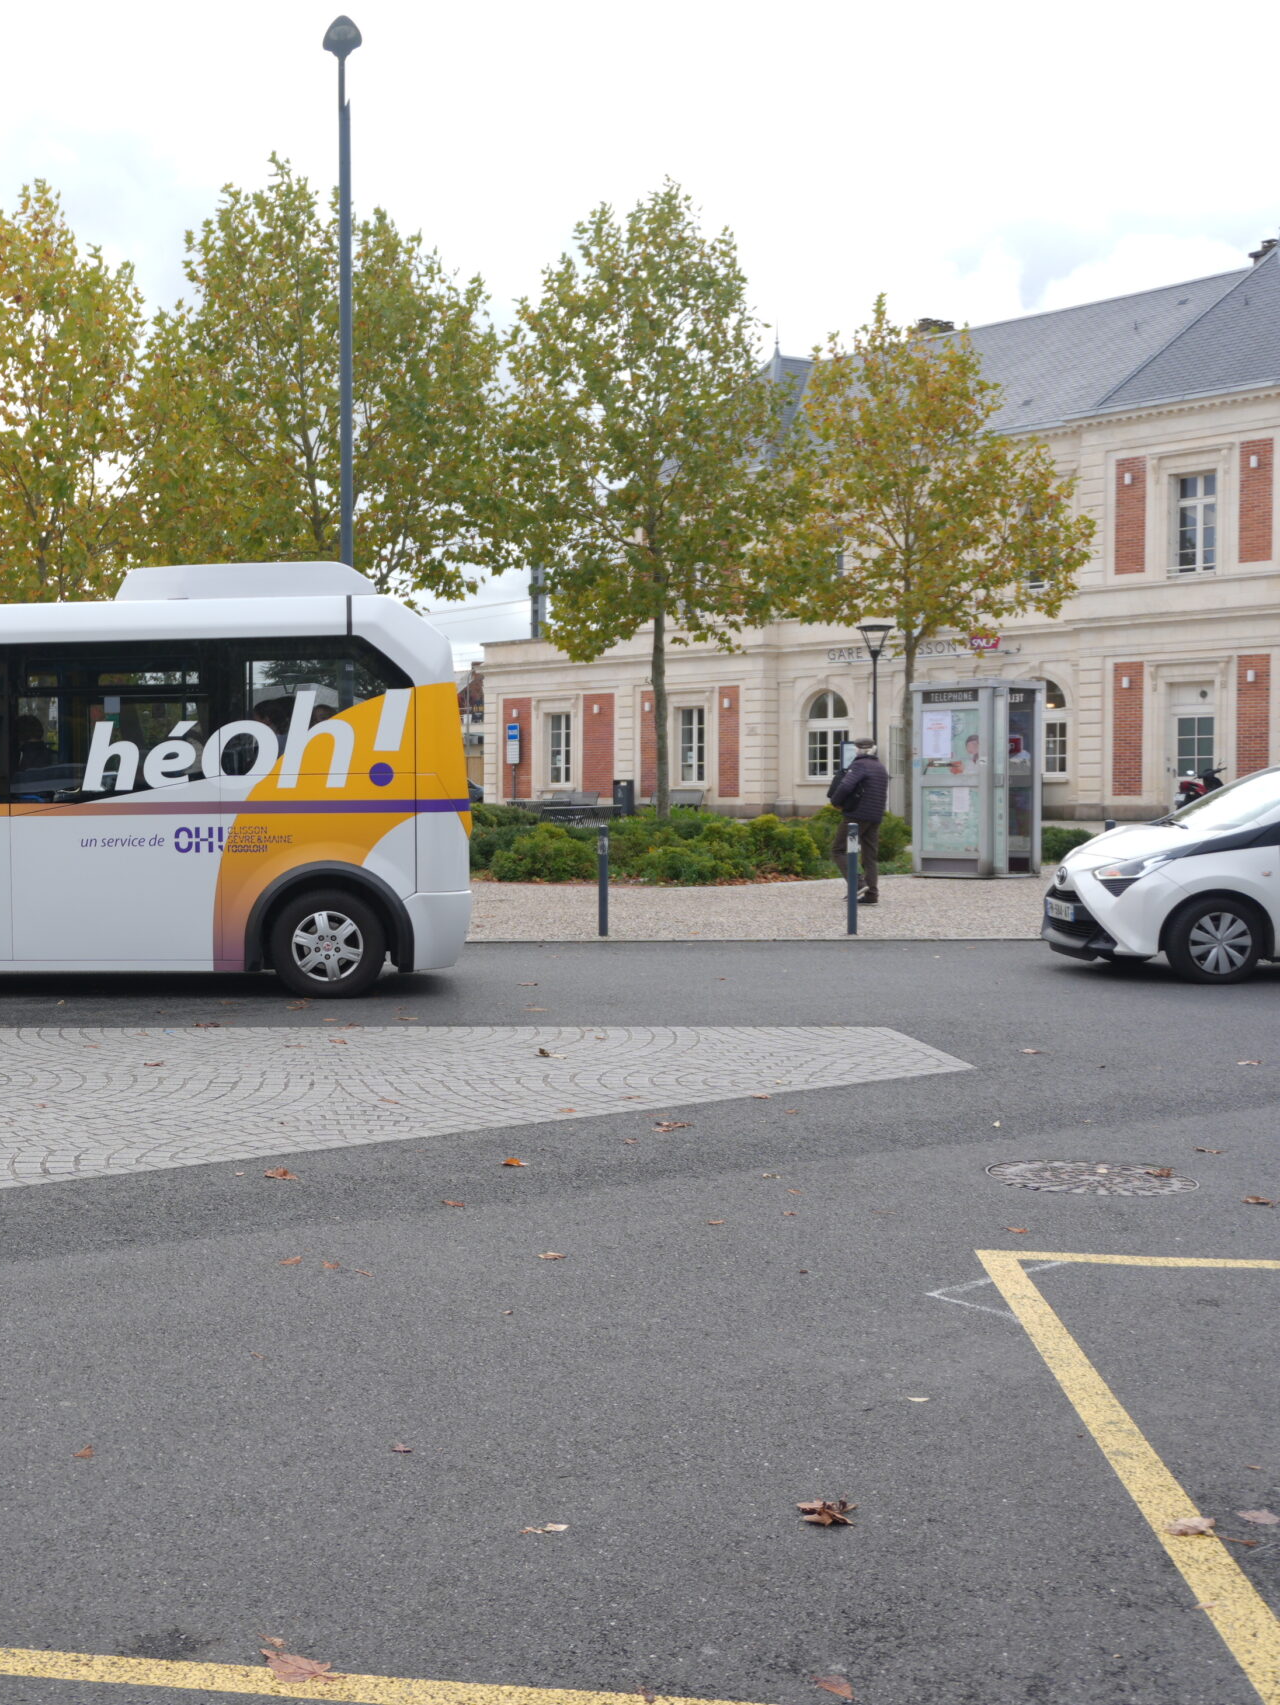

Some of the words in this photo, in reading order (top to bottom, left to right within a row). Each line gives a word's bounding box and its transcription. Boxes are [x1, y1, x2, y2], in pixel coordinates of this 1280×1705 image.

[827, 647, 863, 661] GARE
[930, 691, 974, 702] TELEPHONE
[227, 826, 268, 834] CLISSON
[80, 836, 98, 847] un
[100, 834, 145, 847] service
[148, 834, 165, 847] de
[174, 826, 224, 853] OH!
